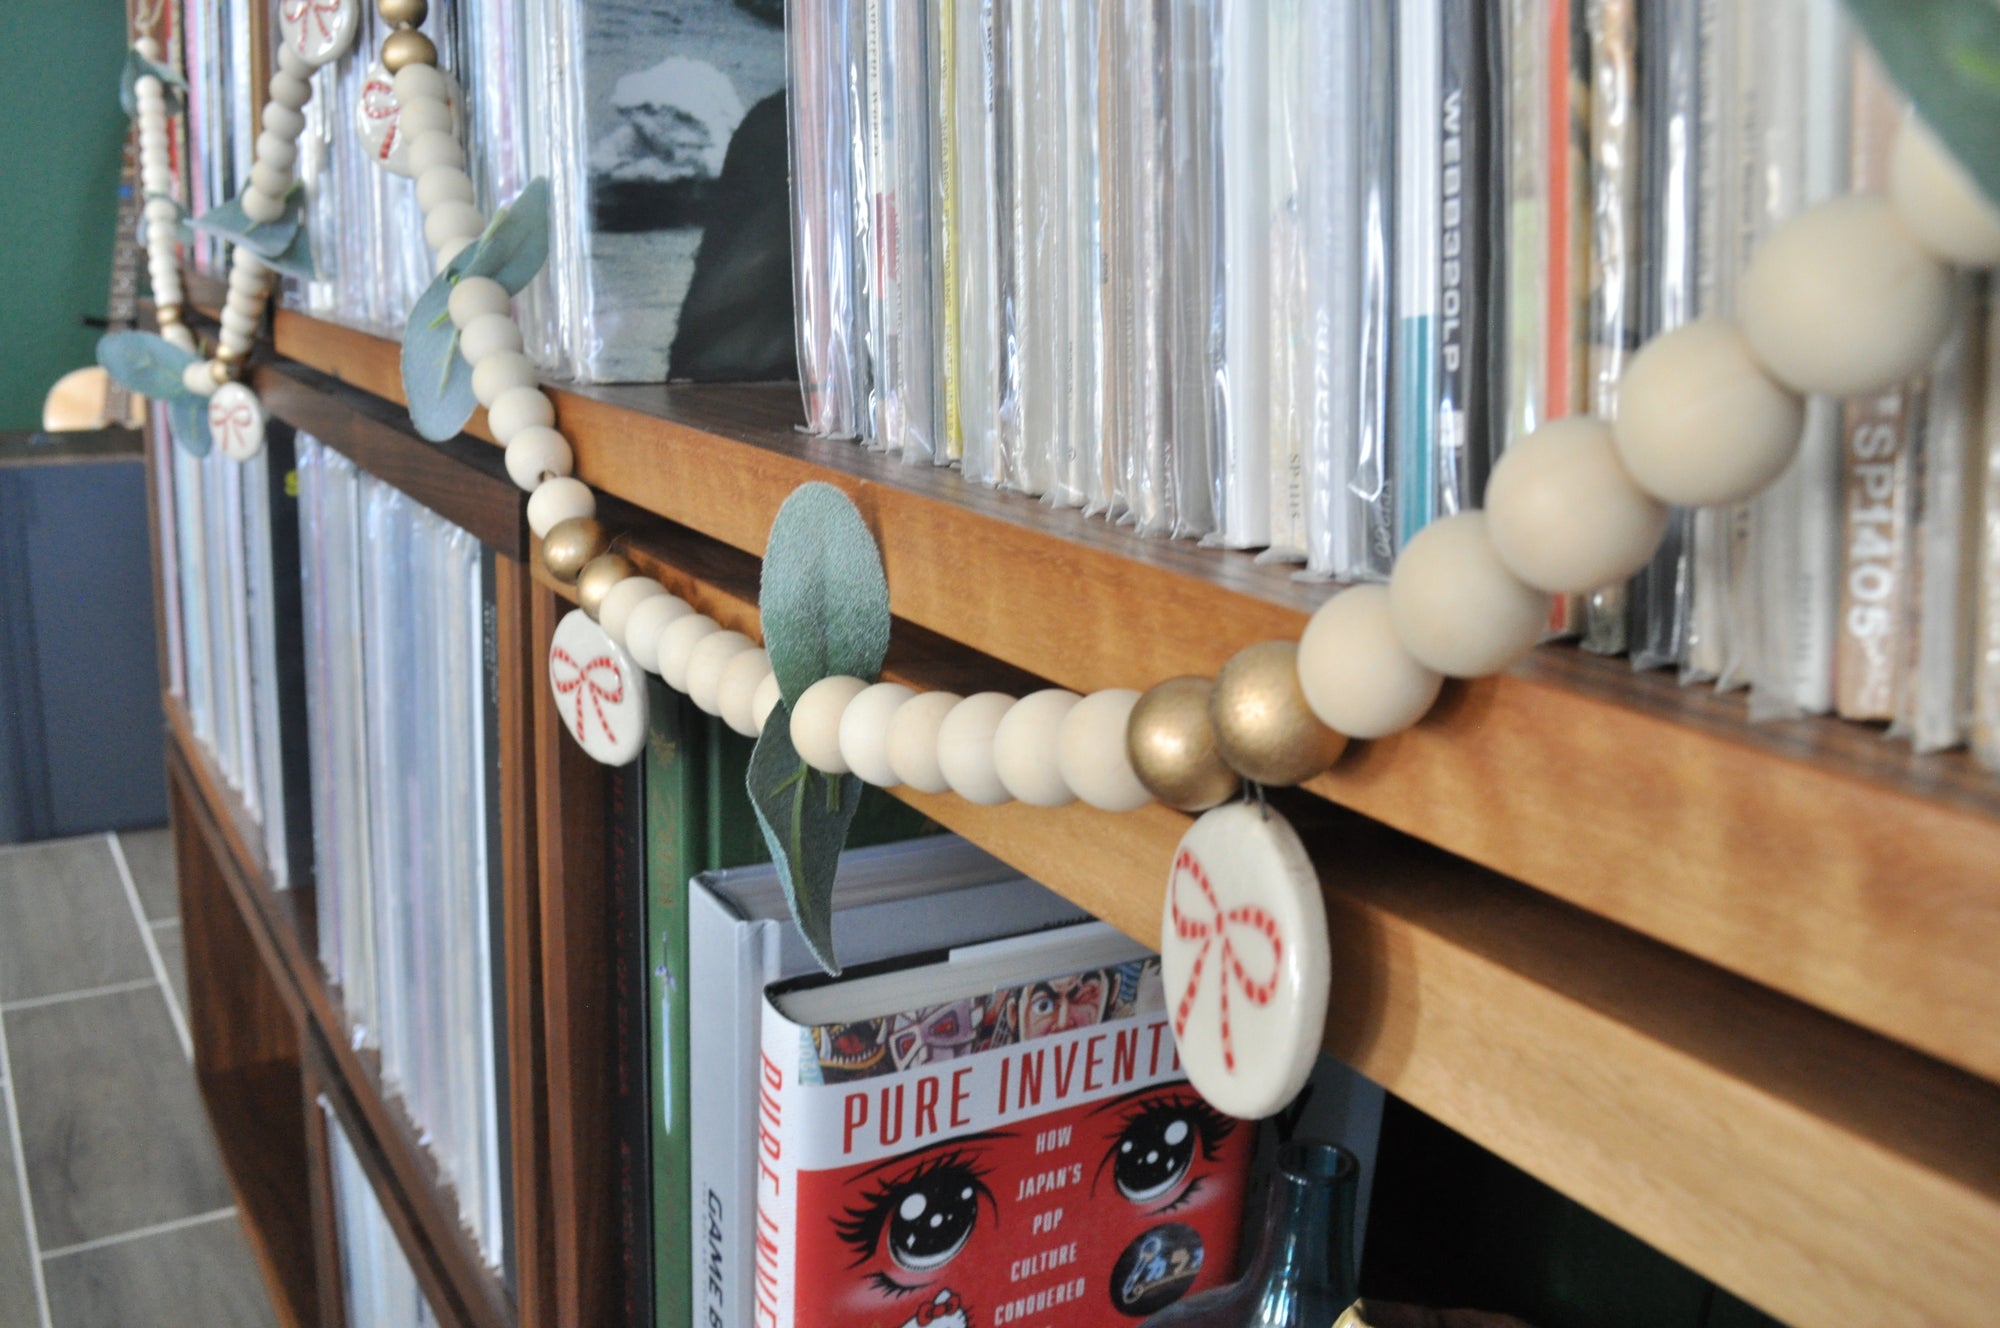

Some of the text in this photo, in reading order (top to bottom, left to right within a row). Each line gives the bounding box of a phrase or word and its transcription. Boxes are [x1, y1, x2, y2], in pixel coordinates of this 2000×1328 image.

[1443, 89, 1462, 373] WEBB320LP
[757, 1048, 784, 1197] PURE
[841, 1066, 974, 1155] PURE
[1035, 1124, 1073, 1155] HOW
[1015, 1162, 1083, 1202] JAPAN'S
[1032, 1207, 1064, 1236] POP
[707, 1187, 724, 1308] GAME
[1010, 1241, 1078, 1283] CULTURE
[993, 1276, 1086, 1327] CONQUERED
